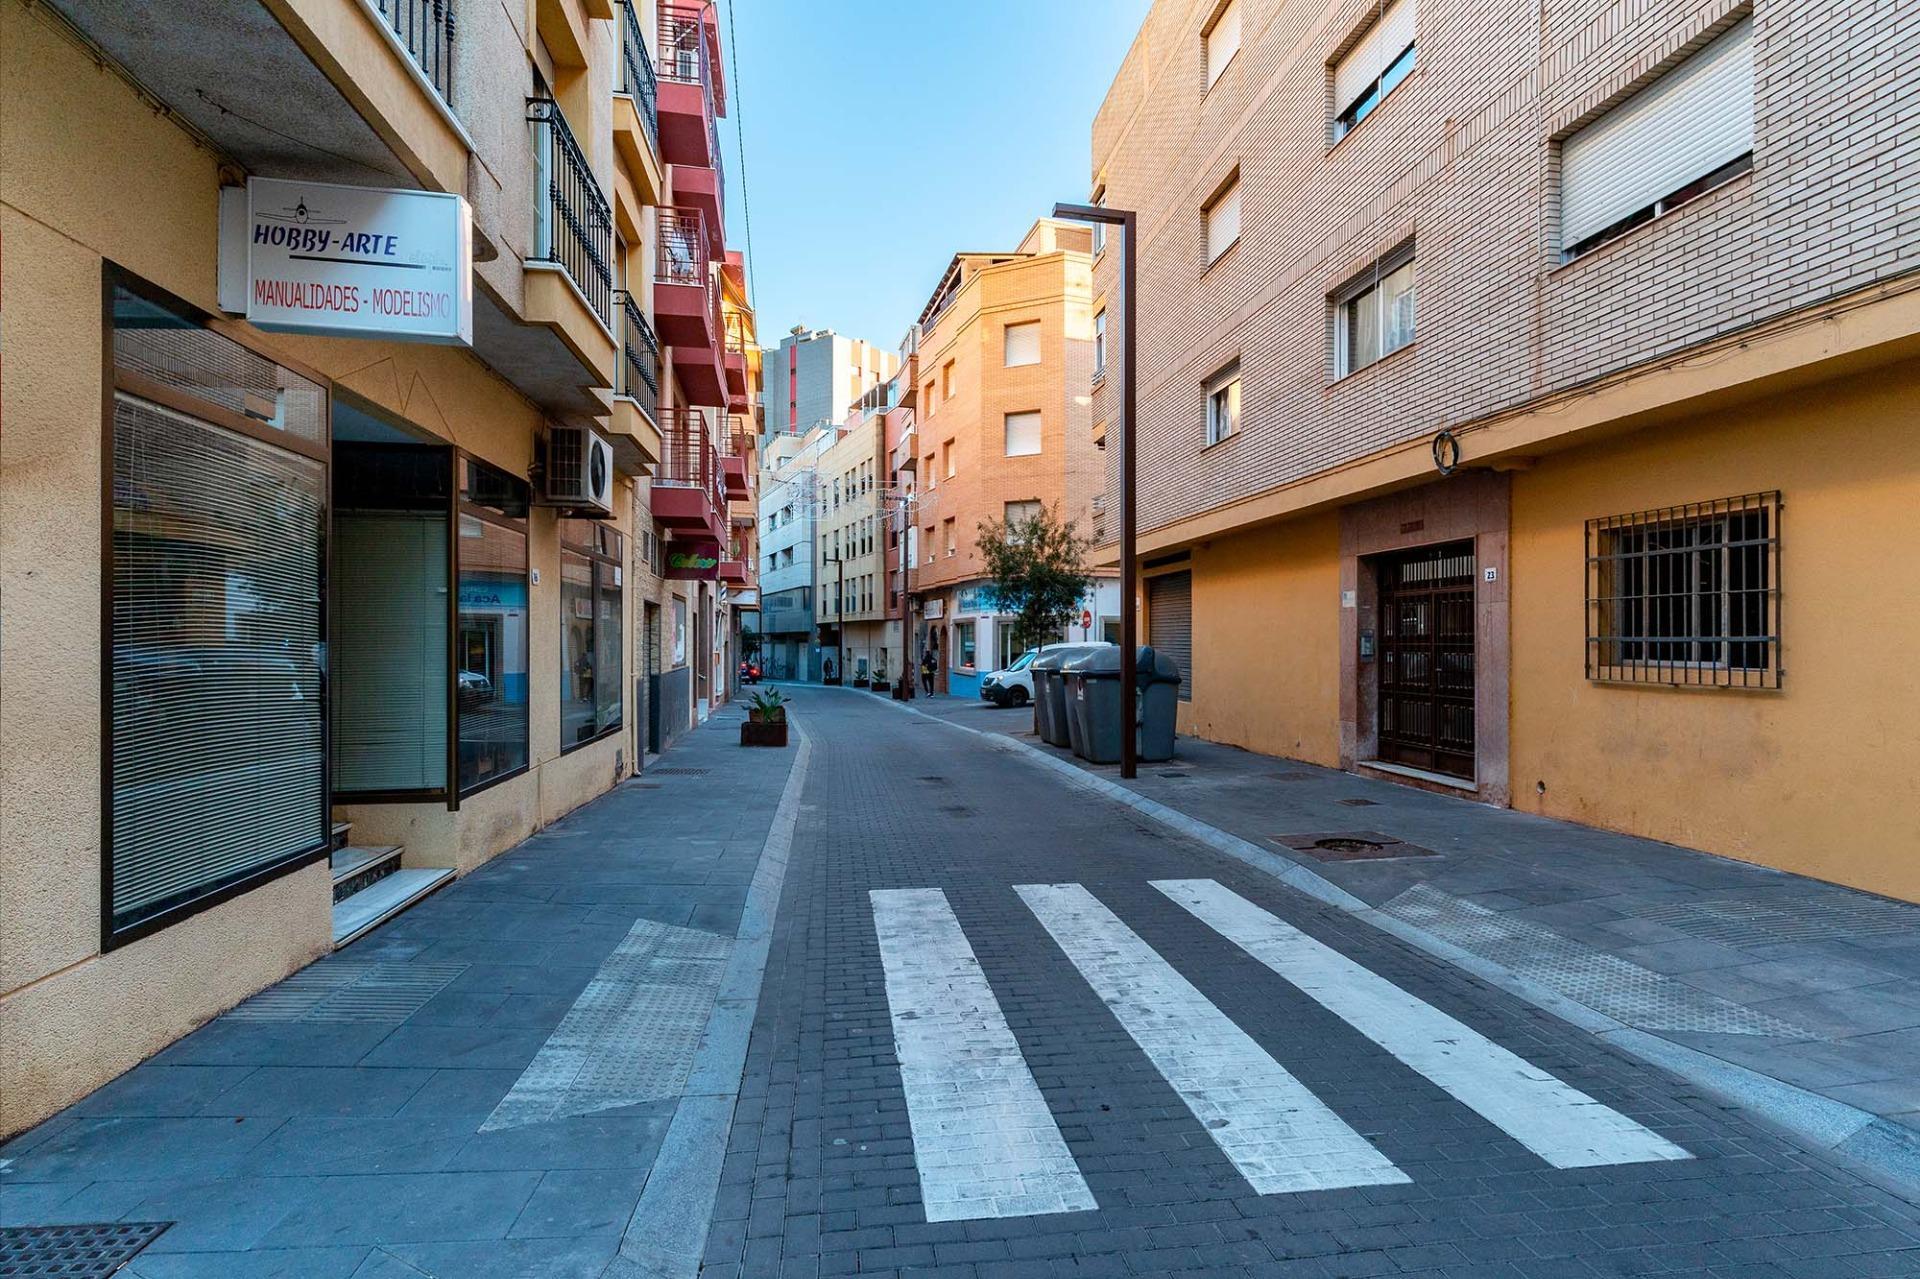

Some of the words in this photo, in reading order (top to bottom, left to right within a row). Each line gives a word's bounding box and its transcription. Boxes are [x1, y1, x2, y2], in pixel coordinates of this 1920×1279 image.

[253, 224, 398, 256] HOBBY-ARTE
[254, 279, 359, 312] MANUALIDADES
[372, 288, 450, 318] MODELISMO
[1487, 571, 1495, 580] 23
